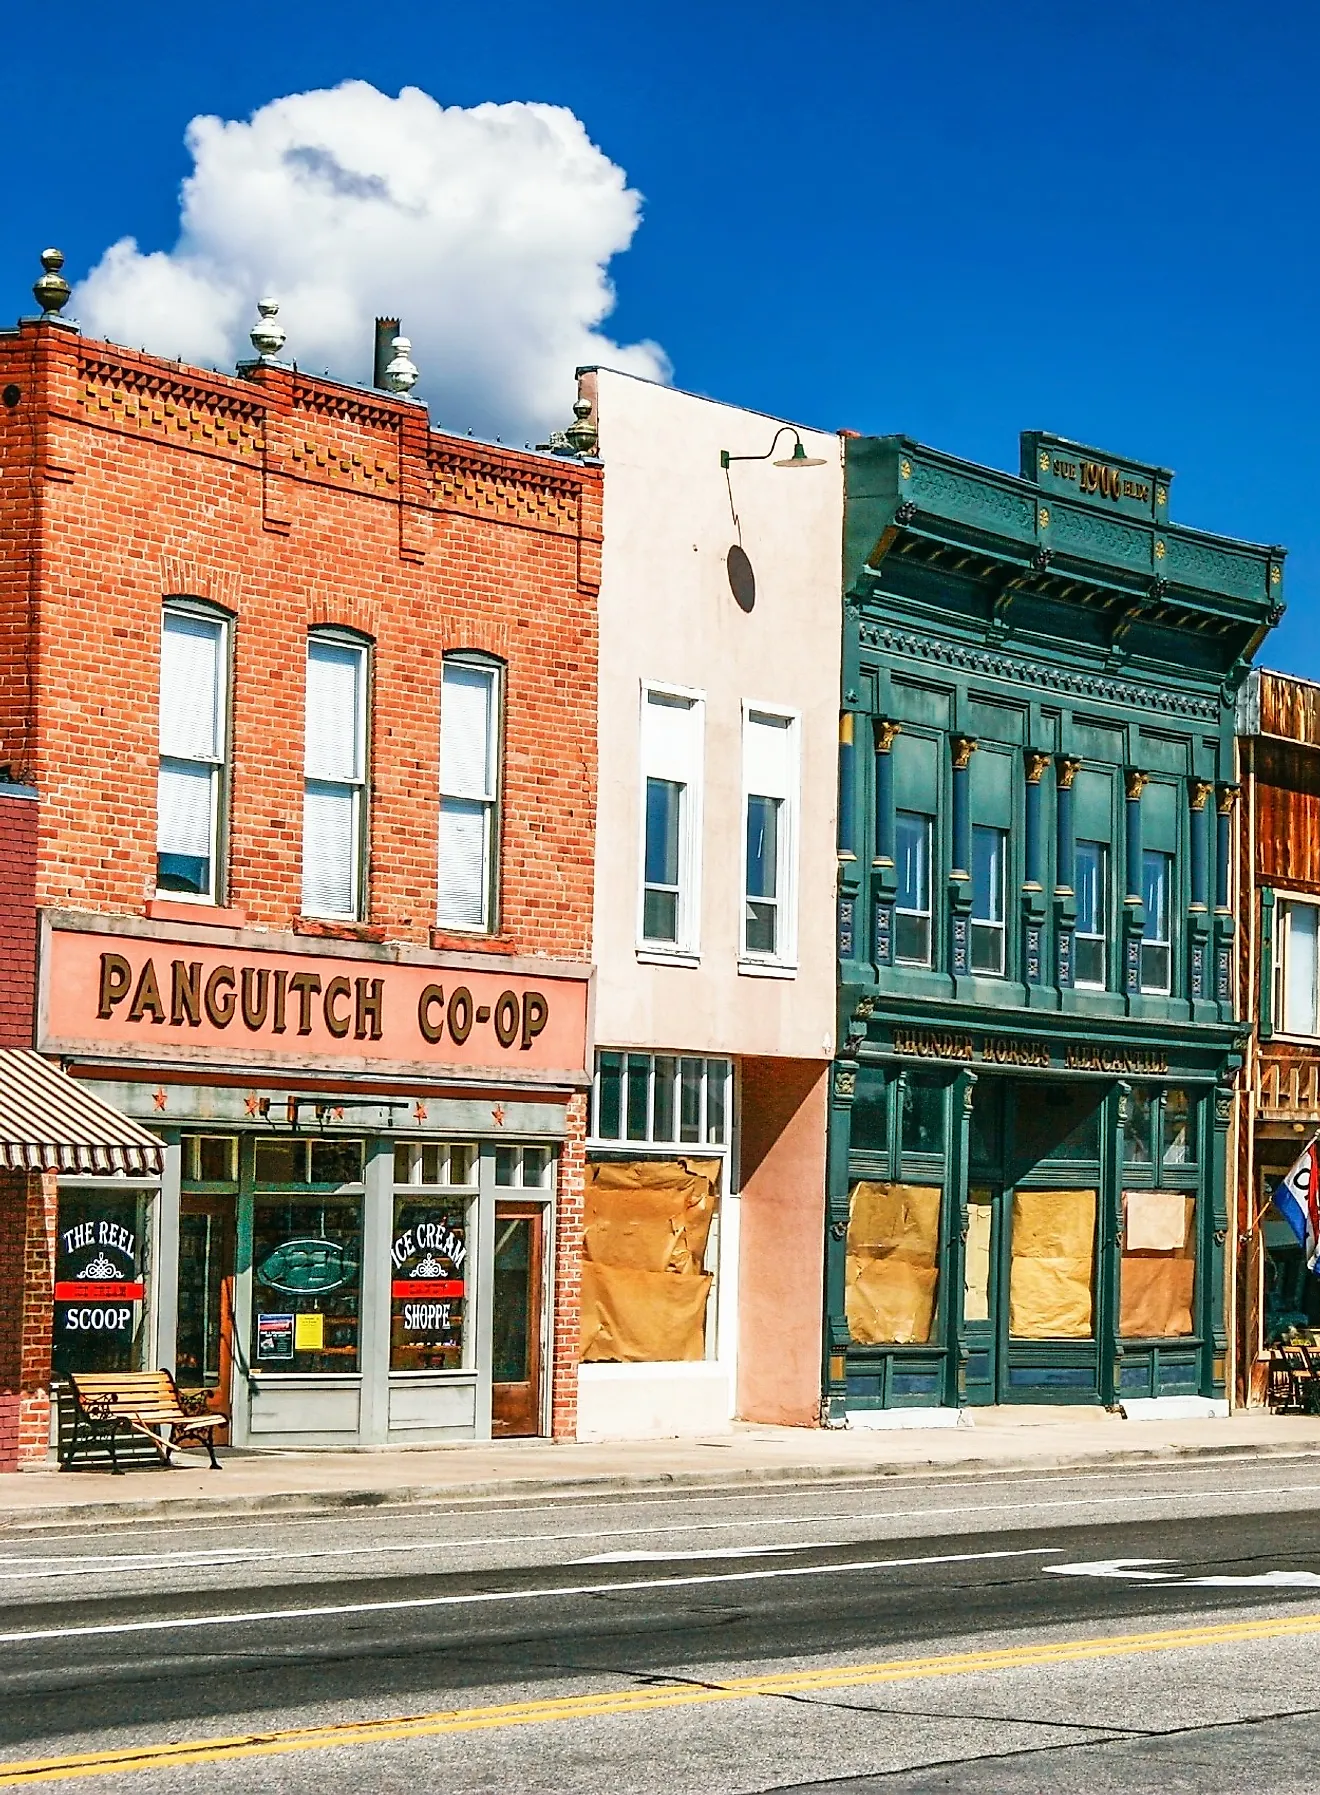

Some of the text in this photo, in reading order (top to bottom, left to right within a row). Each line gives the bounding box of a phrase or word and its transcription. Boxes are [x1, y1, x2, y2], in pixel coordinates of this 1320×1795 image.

[96, 952, 549, 1050] PANGUITCH CO-OP
[982, 1037, 1050, 1068] HORSES
[1064, 1046, 1169, 1075] MERCANTILE
[62, 1220, 135, 1260] THE REEL
[390, 1229, 416, 1269] ICE
[416, 1222, 467, 1270] CREAM
[65, 1308, 131, 1330] SCOOP
[404, 1303, 451, 1330] SHOPPE
